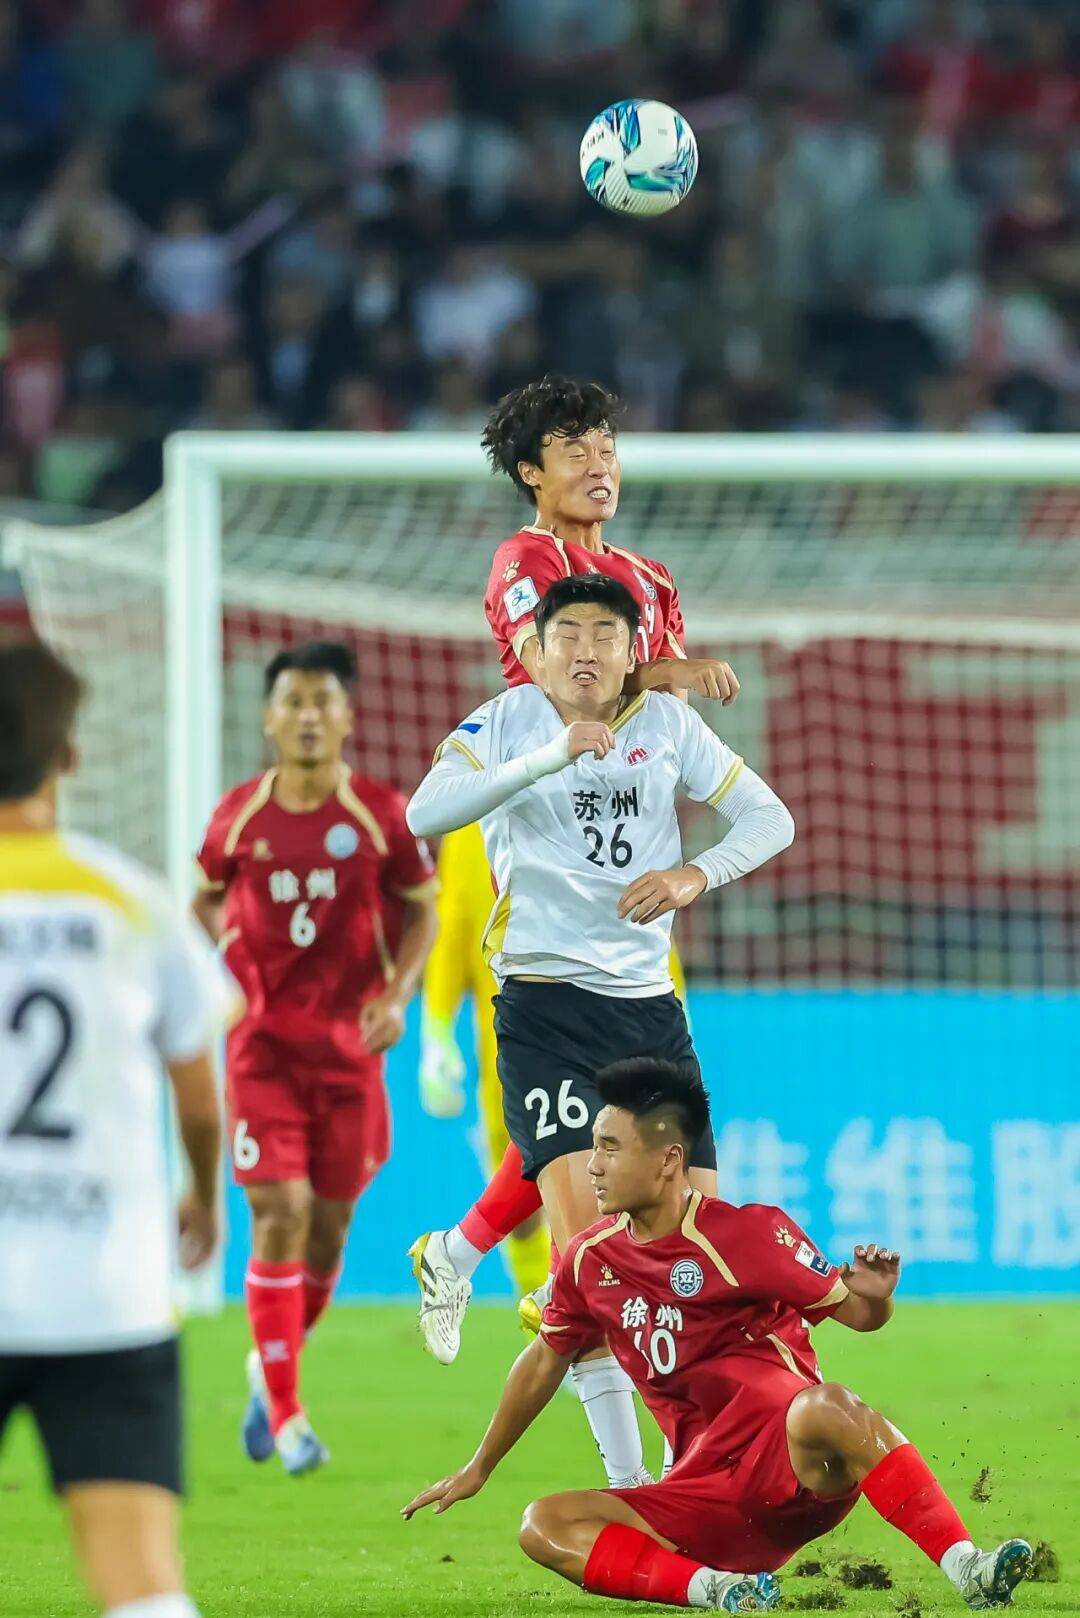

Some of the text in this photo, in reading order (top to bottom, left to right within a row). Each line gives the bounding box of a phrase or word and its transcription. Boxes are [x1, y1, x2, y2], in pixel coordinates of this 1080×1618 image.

[572, 786, 639, 821] 苏州
[582, 823, 633, 869] 26
[289, 901, 317, 948] 6
[6, 984, 76, 1142] 2
[524, 1079, 589, 1141] 26
[233, 1118, 261, 1171] 6
[620, 1296, 683, 1332] 徐州
[633, 1328, 677, 1381] 10
